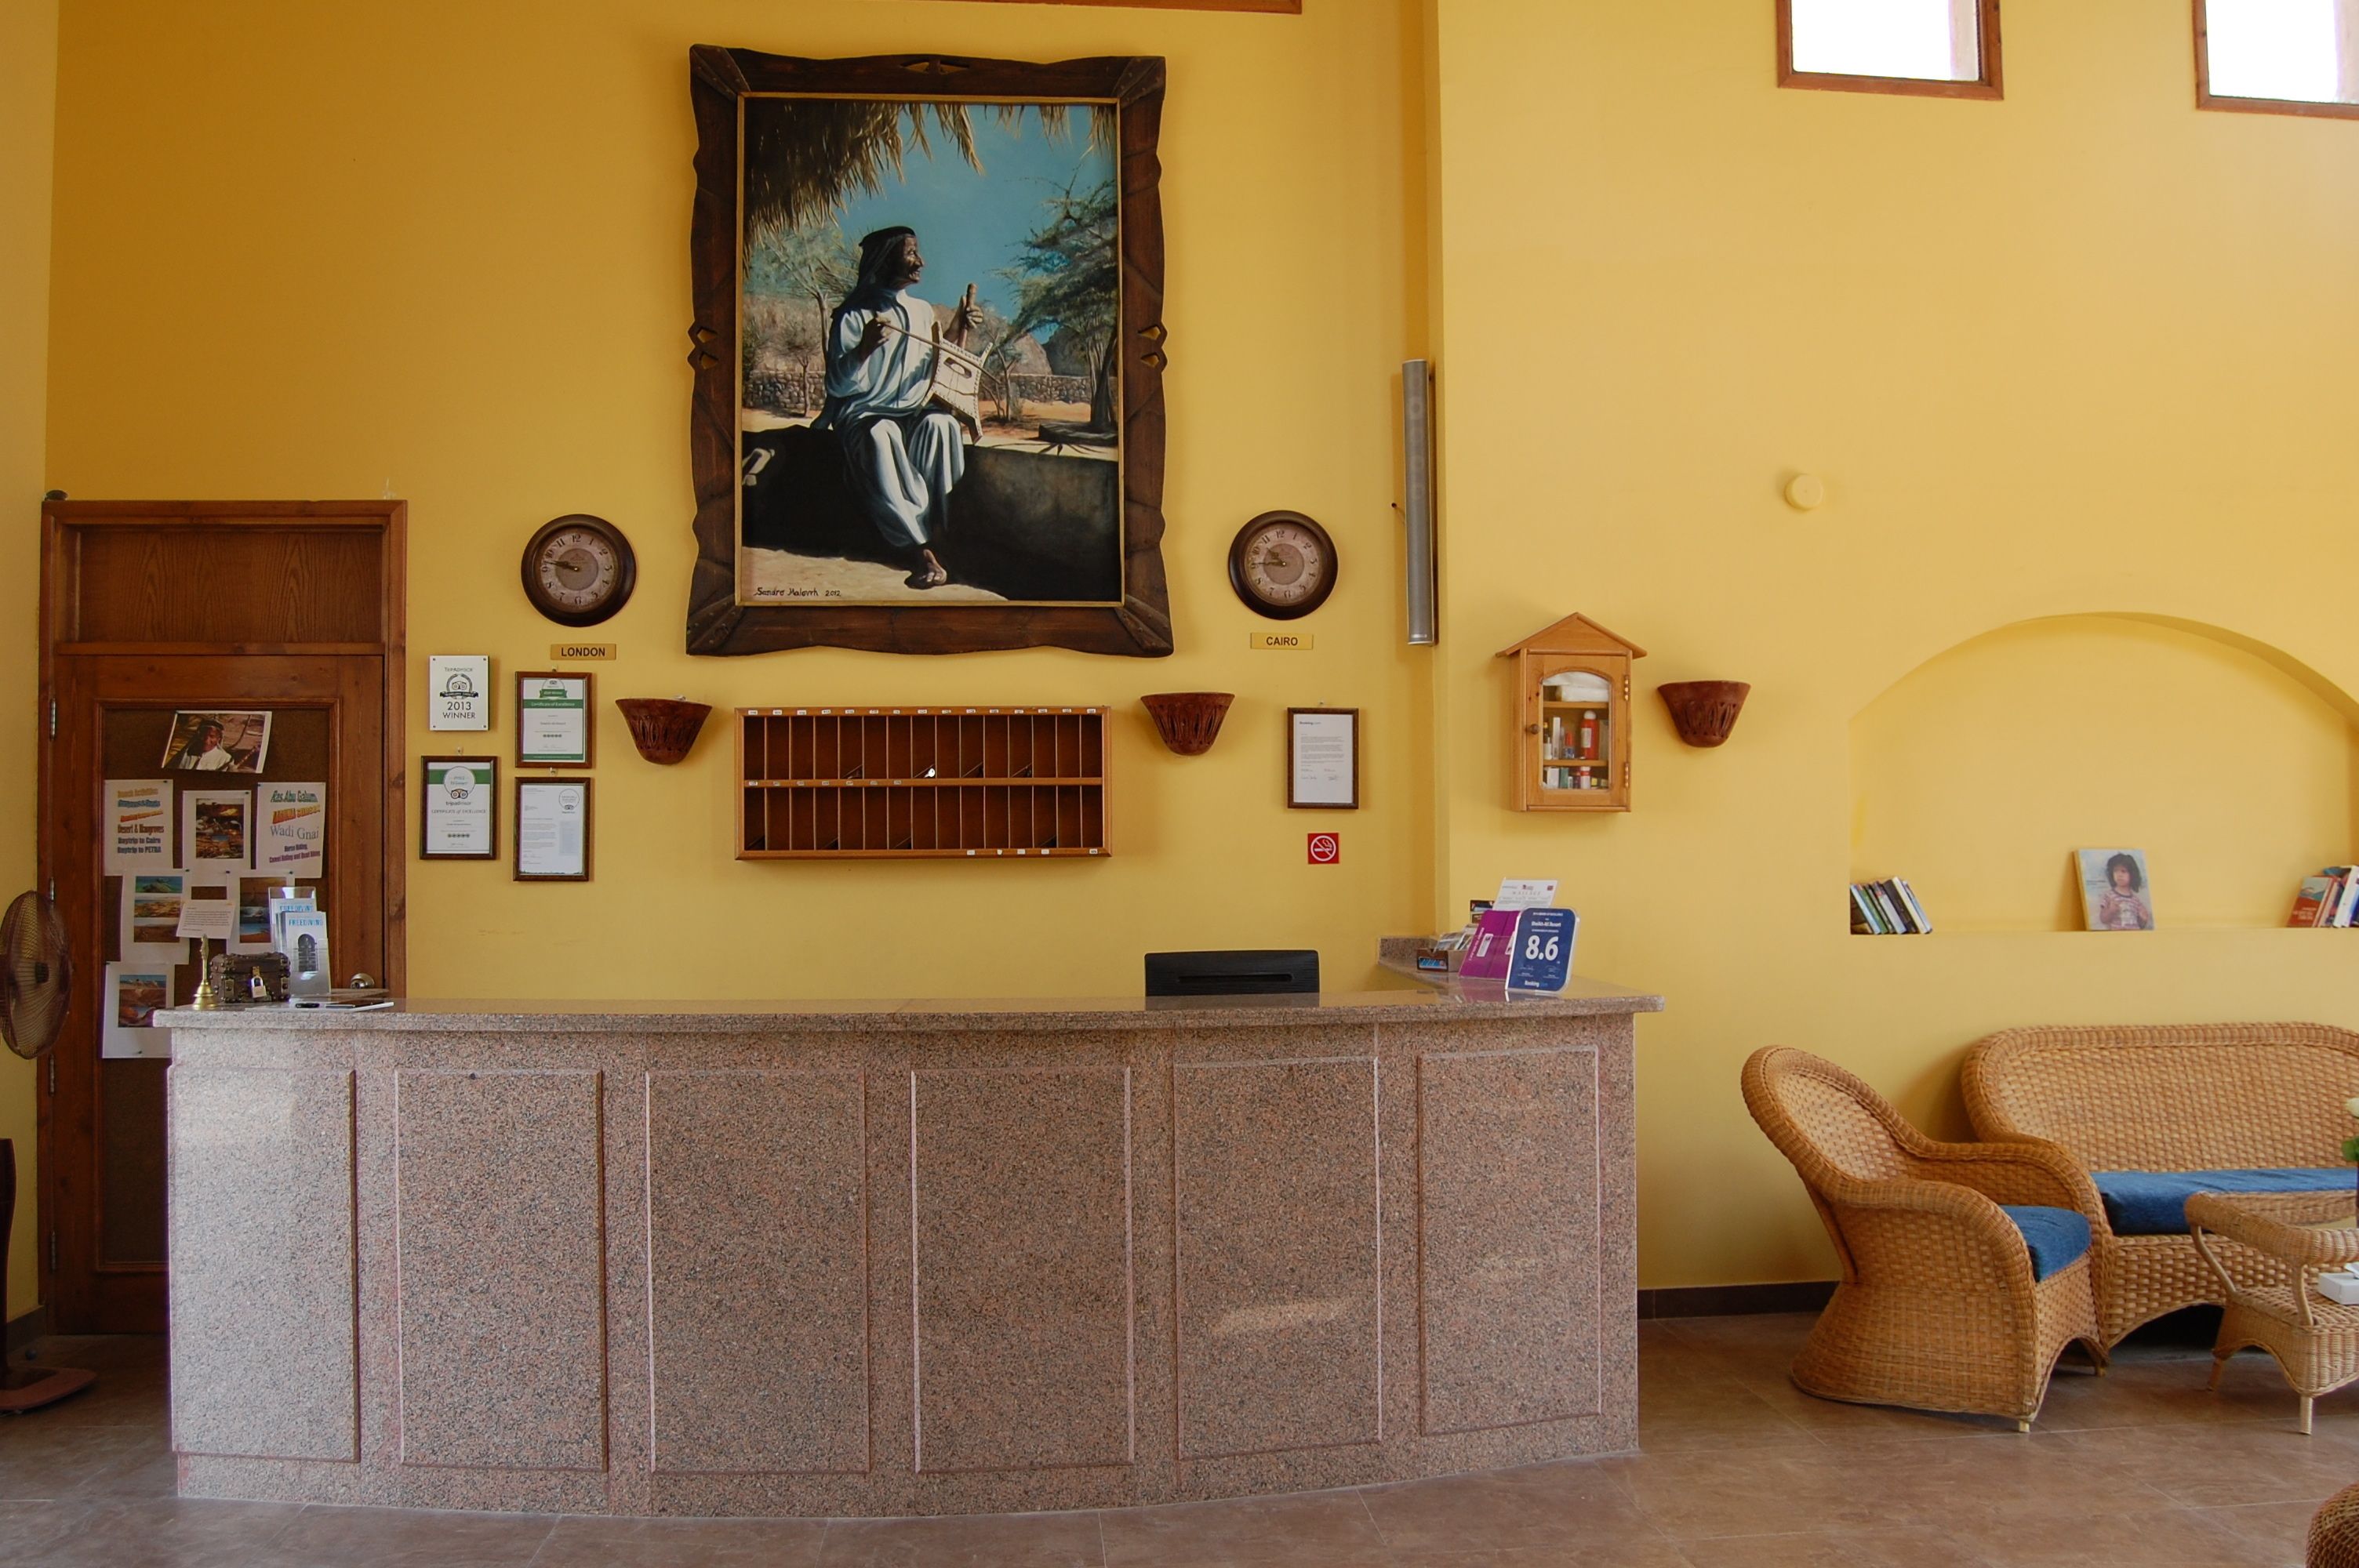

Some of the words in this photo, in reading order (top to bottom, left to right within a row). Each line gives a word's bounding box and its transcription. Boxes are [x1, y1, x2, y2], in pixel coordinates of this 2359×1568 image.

[1266, 636, 1298, 646] CAIRO
[561, 647, 605, 657] LONDON
[447, 702, 471, 710] 2013
[270, 825, 294, 837] Wadi
[1525, 935, 1559, 961] 8.6
